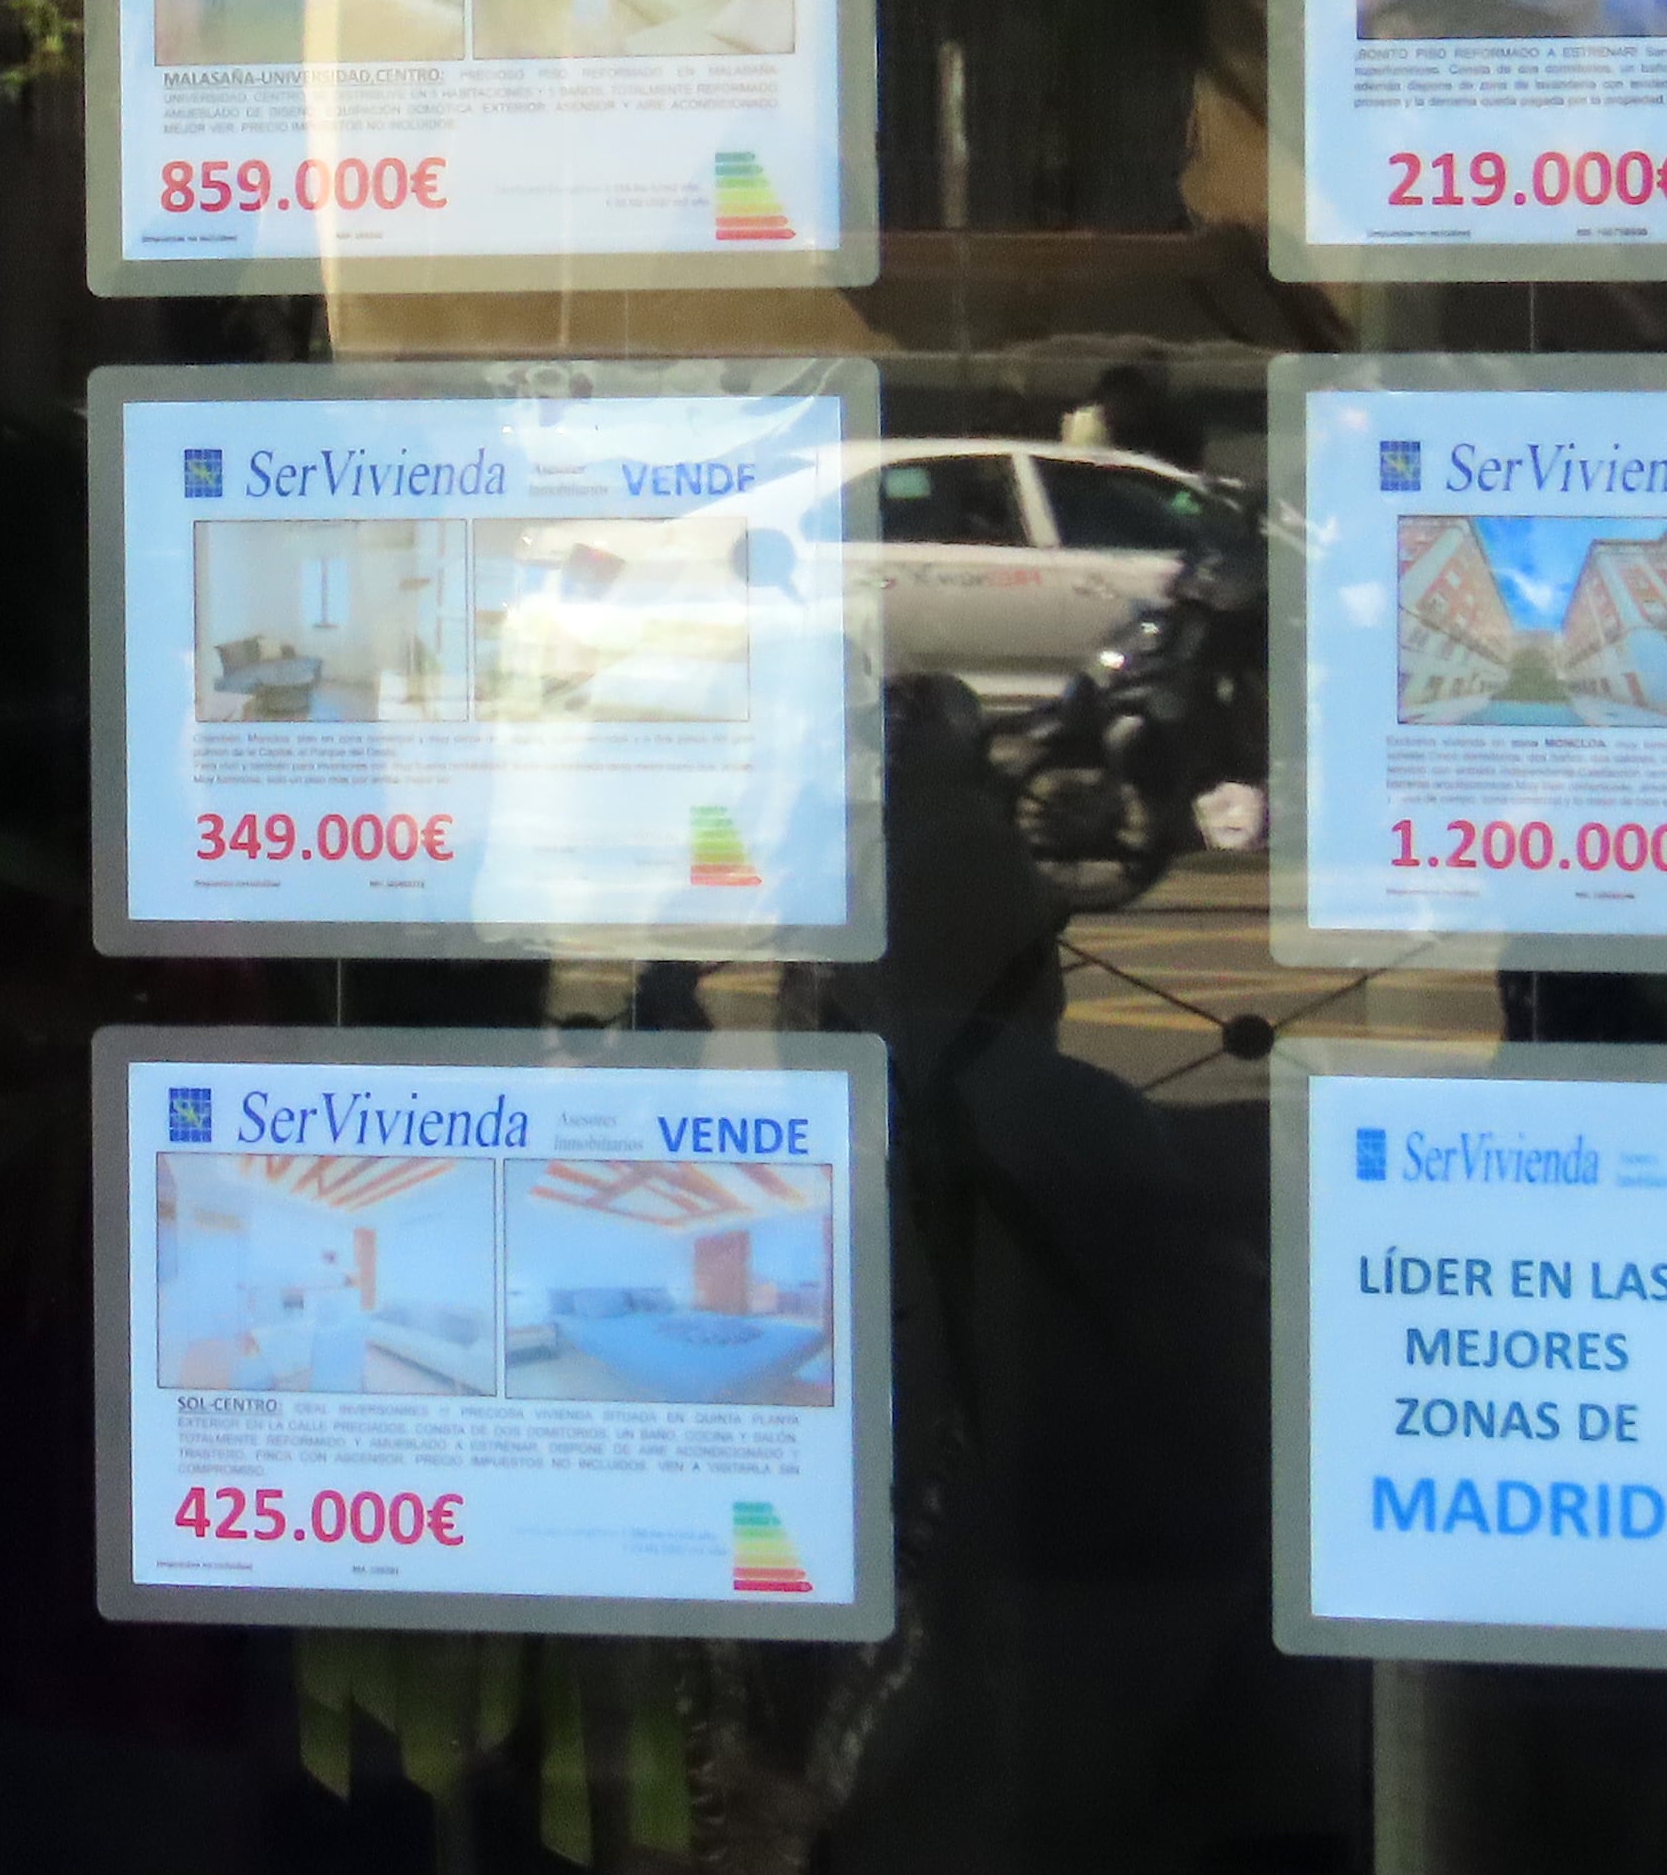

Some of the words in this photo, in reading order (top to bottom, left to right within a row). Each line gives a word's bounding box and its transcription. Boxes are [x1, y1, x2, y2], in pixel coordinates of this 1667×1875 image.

[160, 156, 448, 214] 859.000€
[244, 446, 507, 499] SerVivienda
[621, 462, 757, 497] VENDE
[195, 812, 455, 863] 349.000€
[237, 1090, 529, 1150] SerVivienda
[656, 1114, 810, 1156] VENDE
[1402, 1130, 1600, 1186] SerVivienda
[1359, 1244, 1493, 1298] LÍDER
[1510, 1259, 1572, 1300] EN
[1590, 1261, 1667, 1302] LAS
[1405, 1327, 1630, 1373] MEJORES
[1394, 1397, 1561, 1441] ZONAS
[1577, 1403, 1641, 1443] DE
[173, 1487, 465, 1547] 425.000€
[1371, 1475, 1667, 1542] MADRID
